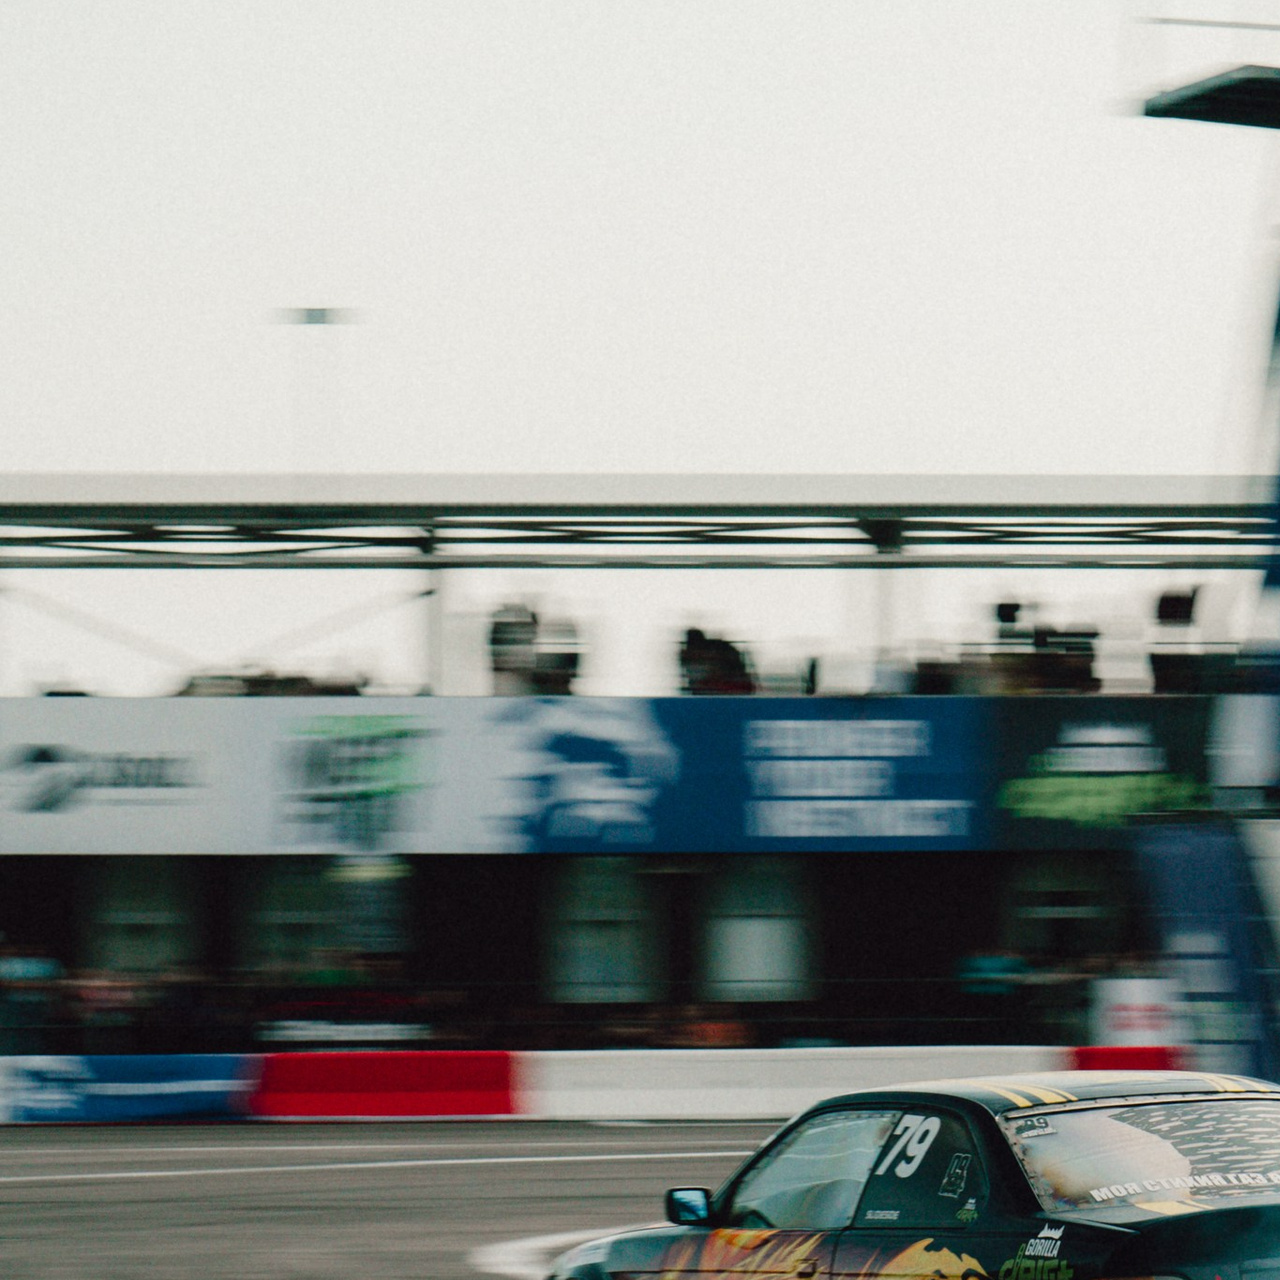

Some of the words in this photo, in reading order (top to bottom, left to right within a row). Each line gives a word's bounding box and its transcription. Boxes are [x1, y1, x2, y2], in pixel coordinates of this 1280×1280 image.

[875, 1114, 941, 1178] 79
[1090, 1180, 1142, 1202] МОЯ
[1142, 1172, 1222, 1192] СТИХИЯ
[1225, 1171, 1267, 1186] ГАЗ
[1025, 1239, 1061, 1258] GORILLA
